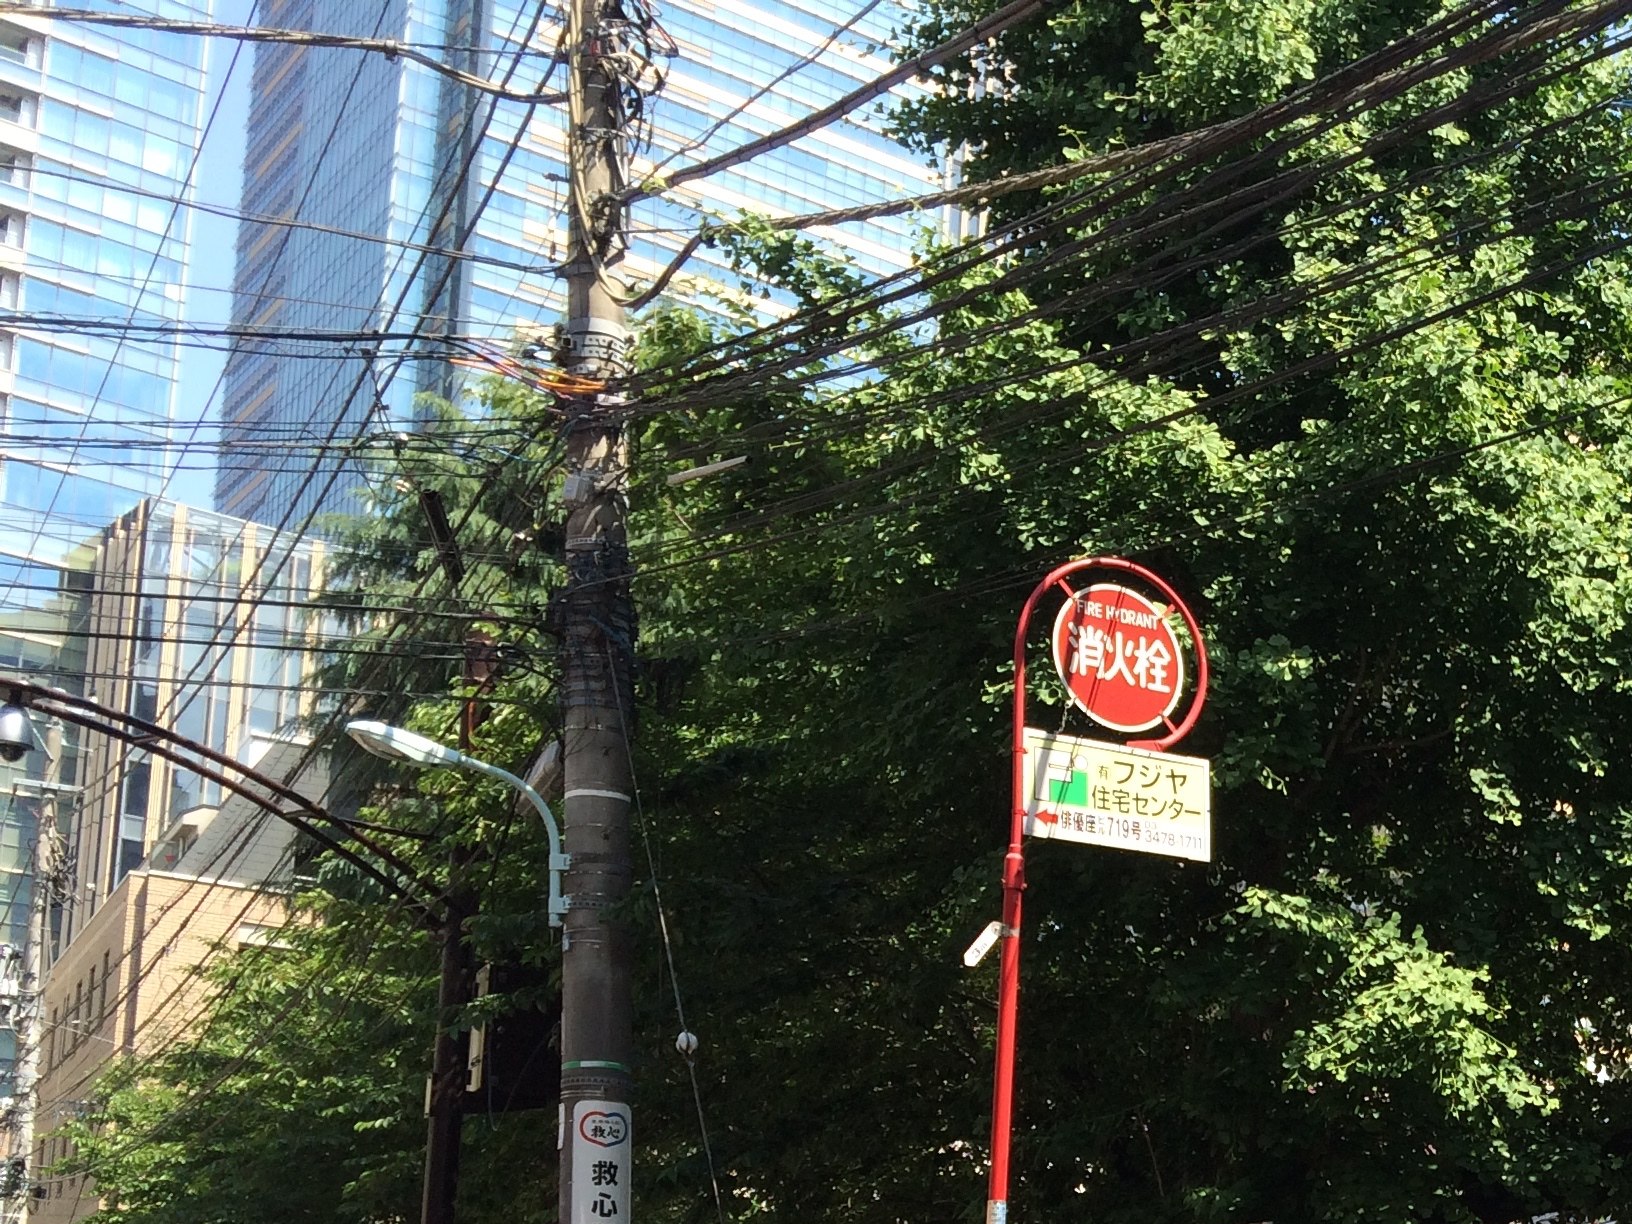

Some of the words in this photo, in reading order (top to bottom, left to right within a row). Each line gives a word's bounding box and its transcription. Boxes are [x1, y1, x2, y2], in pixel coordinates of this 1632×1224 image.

[1077, 599, 1103, 619] FIRE
[1105, 604, 1158, 630] HYDRANT
[1067, 621, 1171, 693] 消火栓
[1113, 760, 1188, 795] フジヤ
[1091, 784, 1202, 820] 住宅センター
[591, 1125, 620, 1139] 救心
